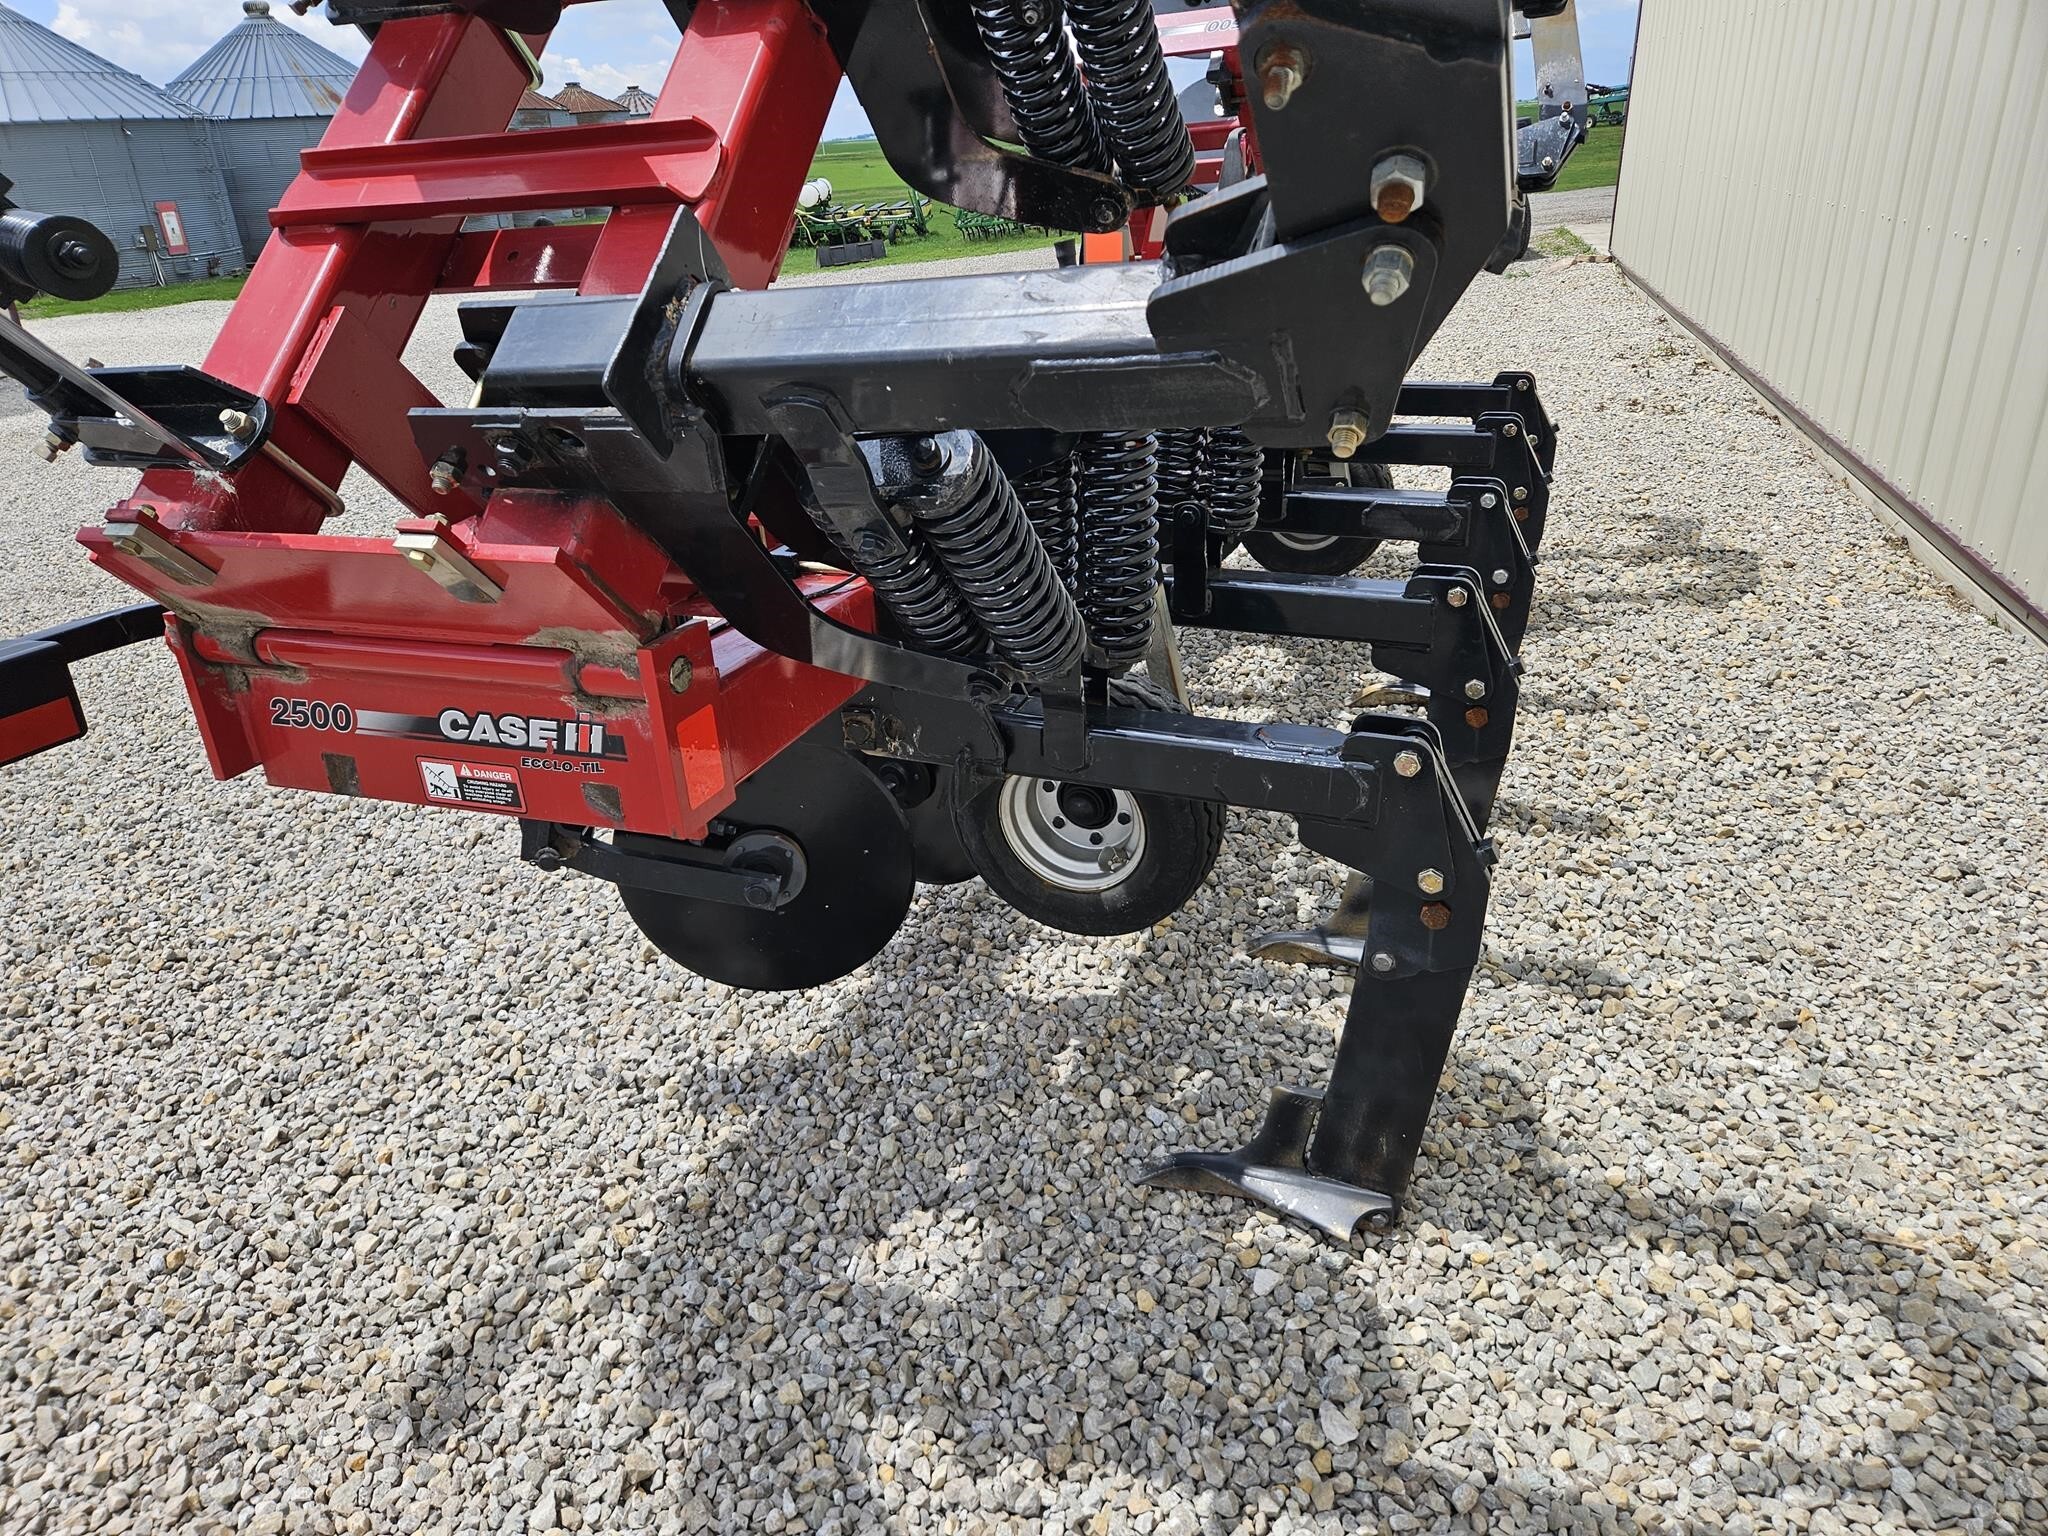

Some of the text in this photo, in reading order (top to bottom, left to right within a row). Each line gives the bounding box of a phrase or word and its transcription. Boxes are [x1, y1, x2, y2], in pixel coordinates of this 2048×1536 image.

[269, 697, 353, 733] 2500
[438, 708, 558, 751] CASE
[473, 769, 512, 781] DANGER
